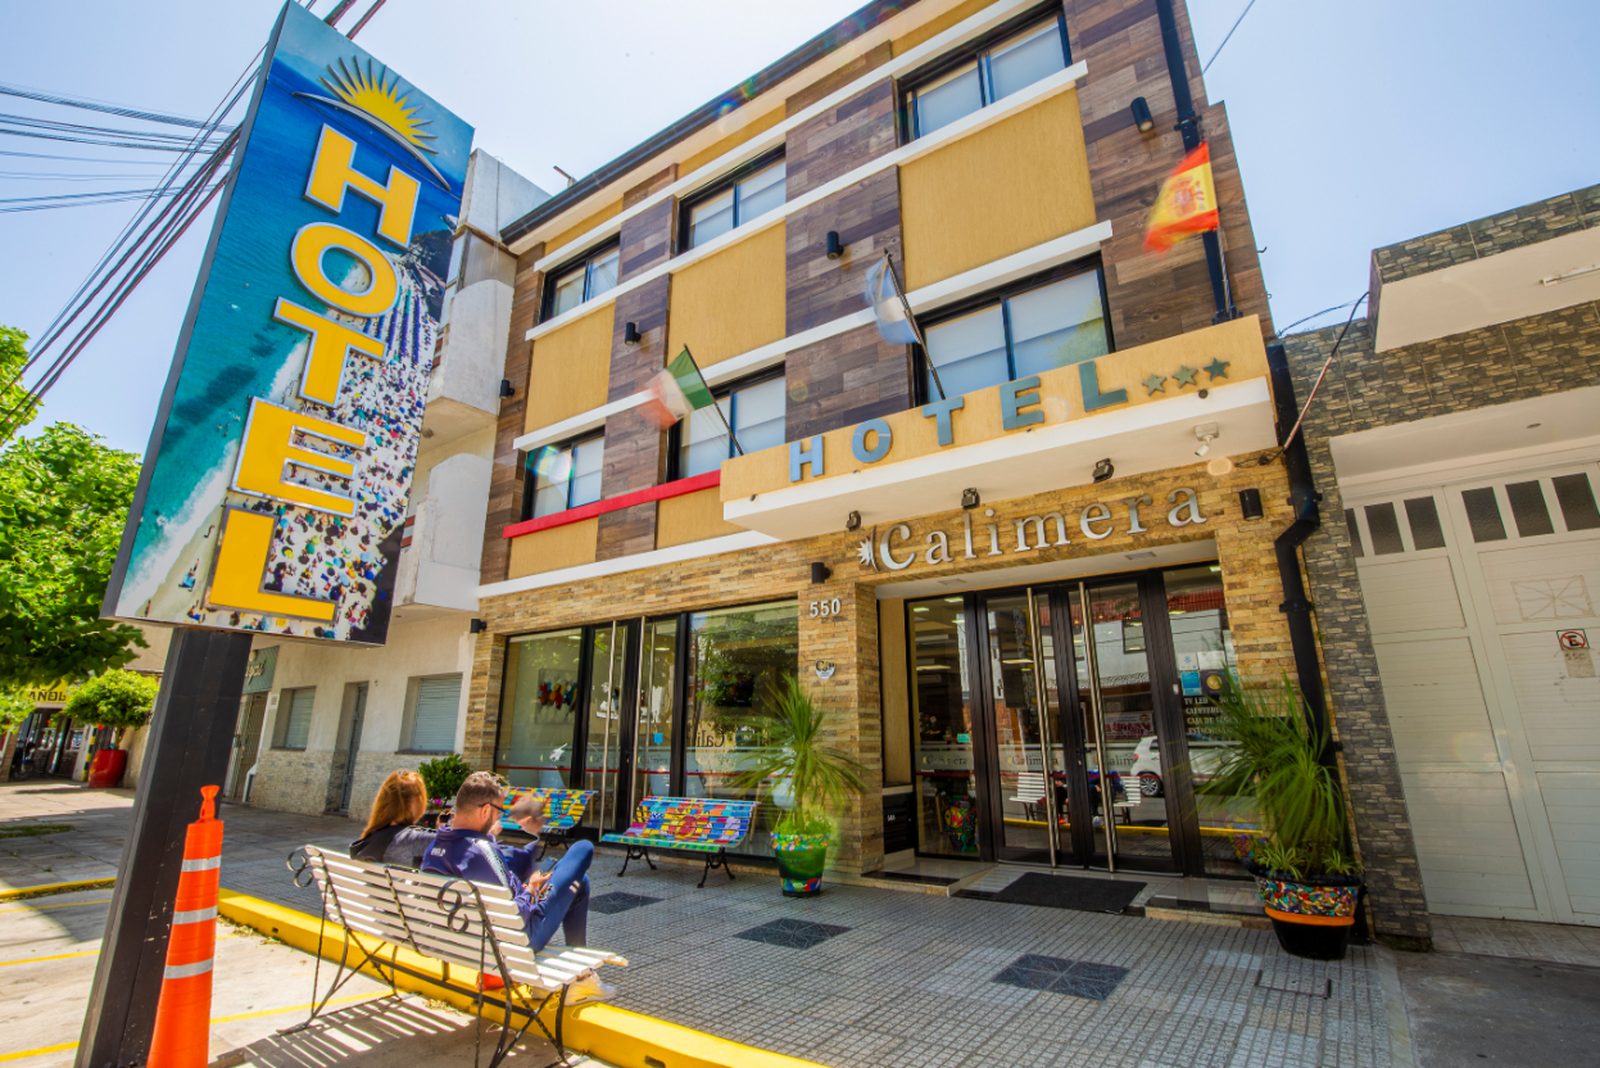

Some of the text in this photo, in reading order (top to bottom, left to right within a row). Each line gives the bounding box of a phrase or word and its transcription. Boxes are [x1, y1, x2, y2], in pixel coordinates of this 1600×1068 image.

[206, 122, 422, 624] HOTEL
[789, 359, 1129, 484] HOTEL
[879, 486, 1208, 571] Calimera
[809, 597, 842, 618] 550
